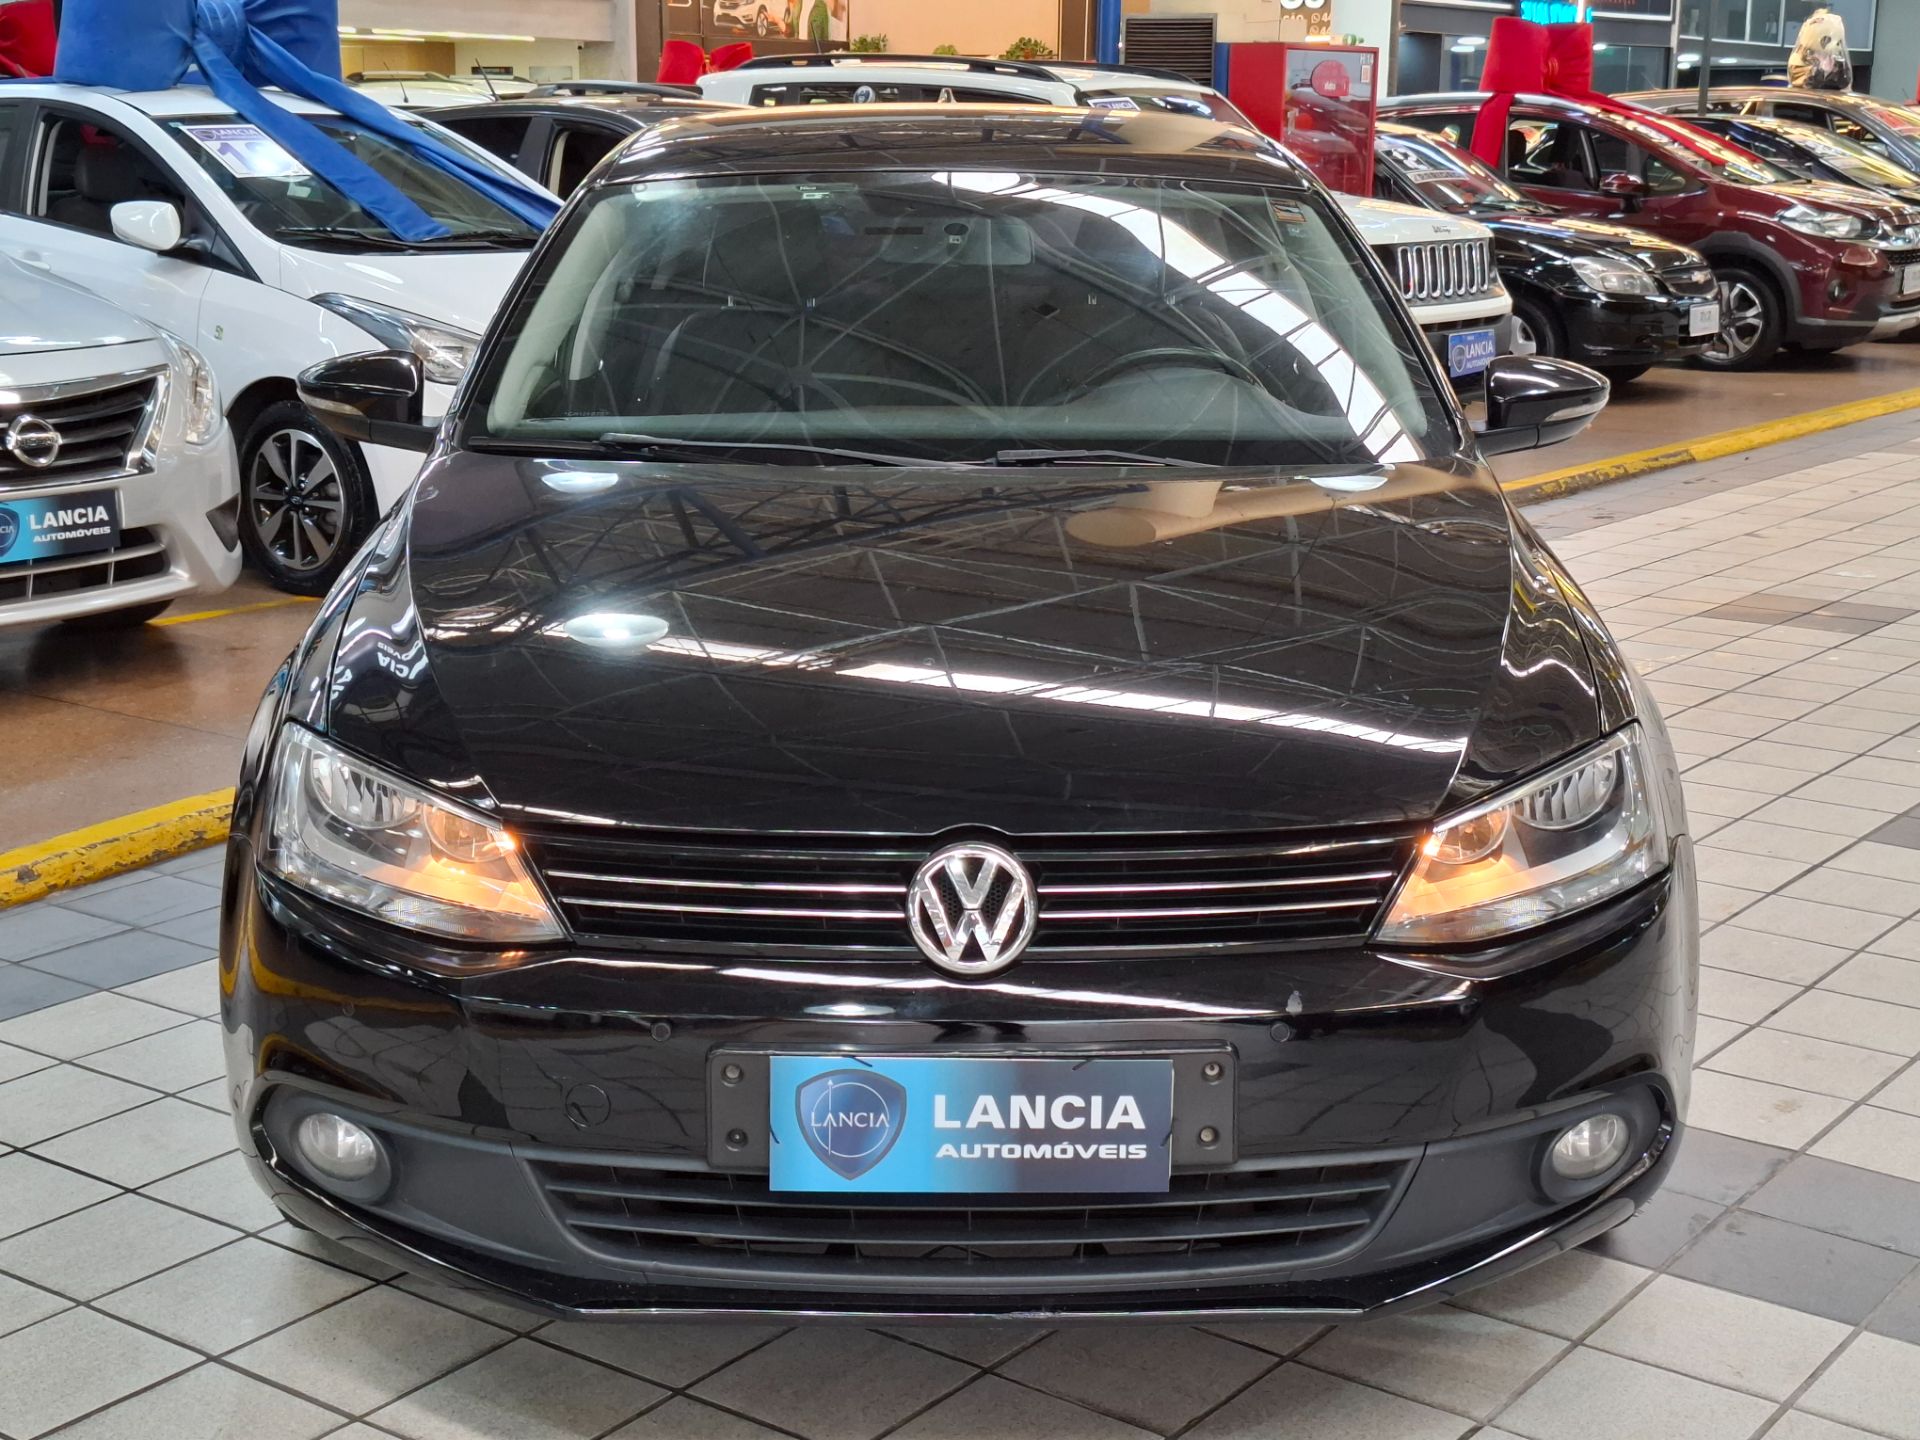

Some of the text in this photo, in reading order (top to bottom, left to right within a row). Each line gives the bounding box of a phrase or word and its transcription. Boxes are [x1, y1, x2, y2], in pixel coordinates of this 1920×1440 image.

[1465, 340, 1494, 359] LANCIA
[29, 505, 109, 530] LANCIA
[32, 526, 111, 544] AUTOMÓVEIS
[810, 1110, 891, 1129] LANCIA
[933, 1094, 1147, 1130] LANCIA
[935, 1141, 1148, 1160] AUTOMÓVEIS
